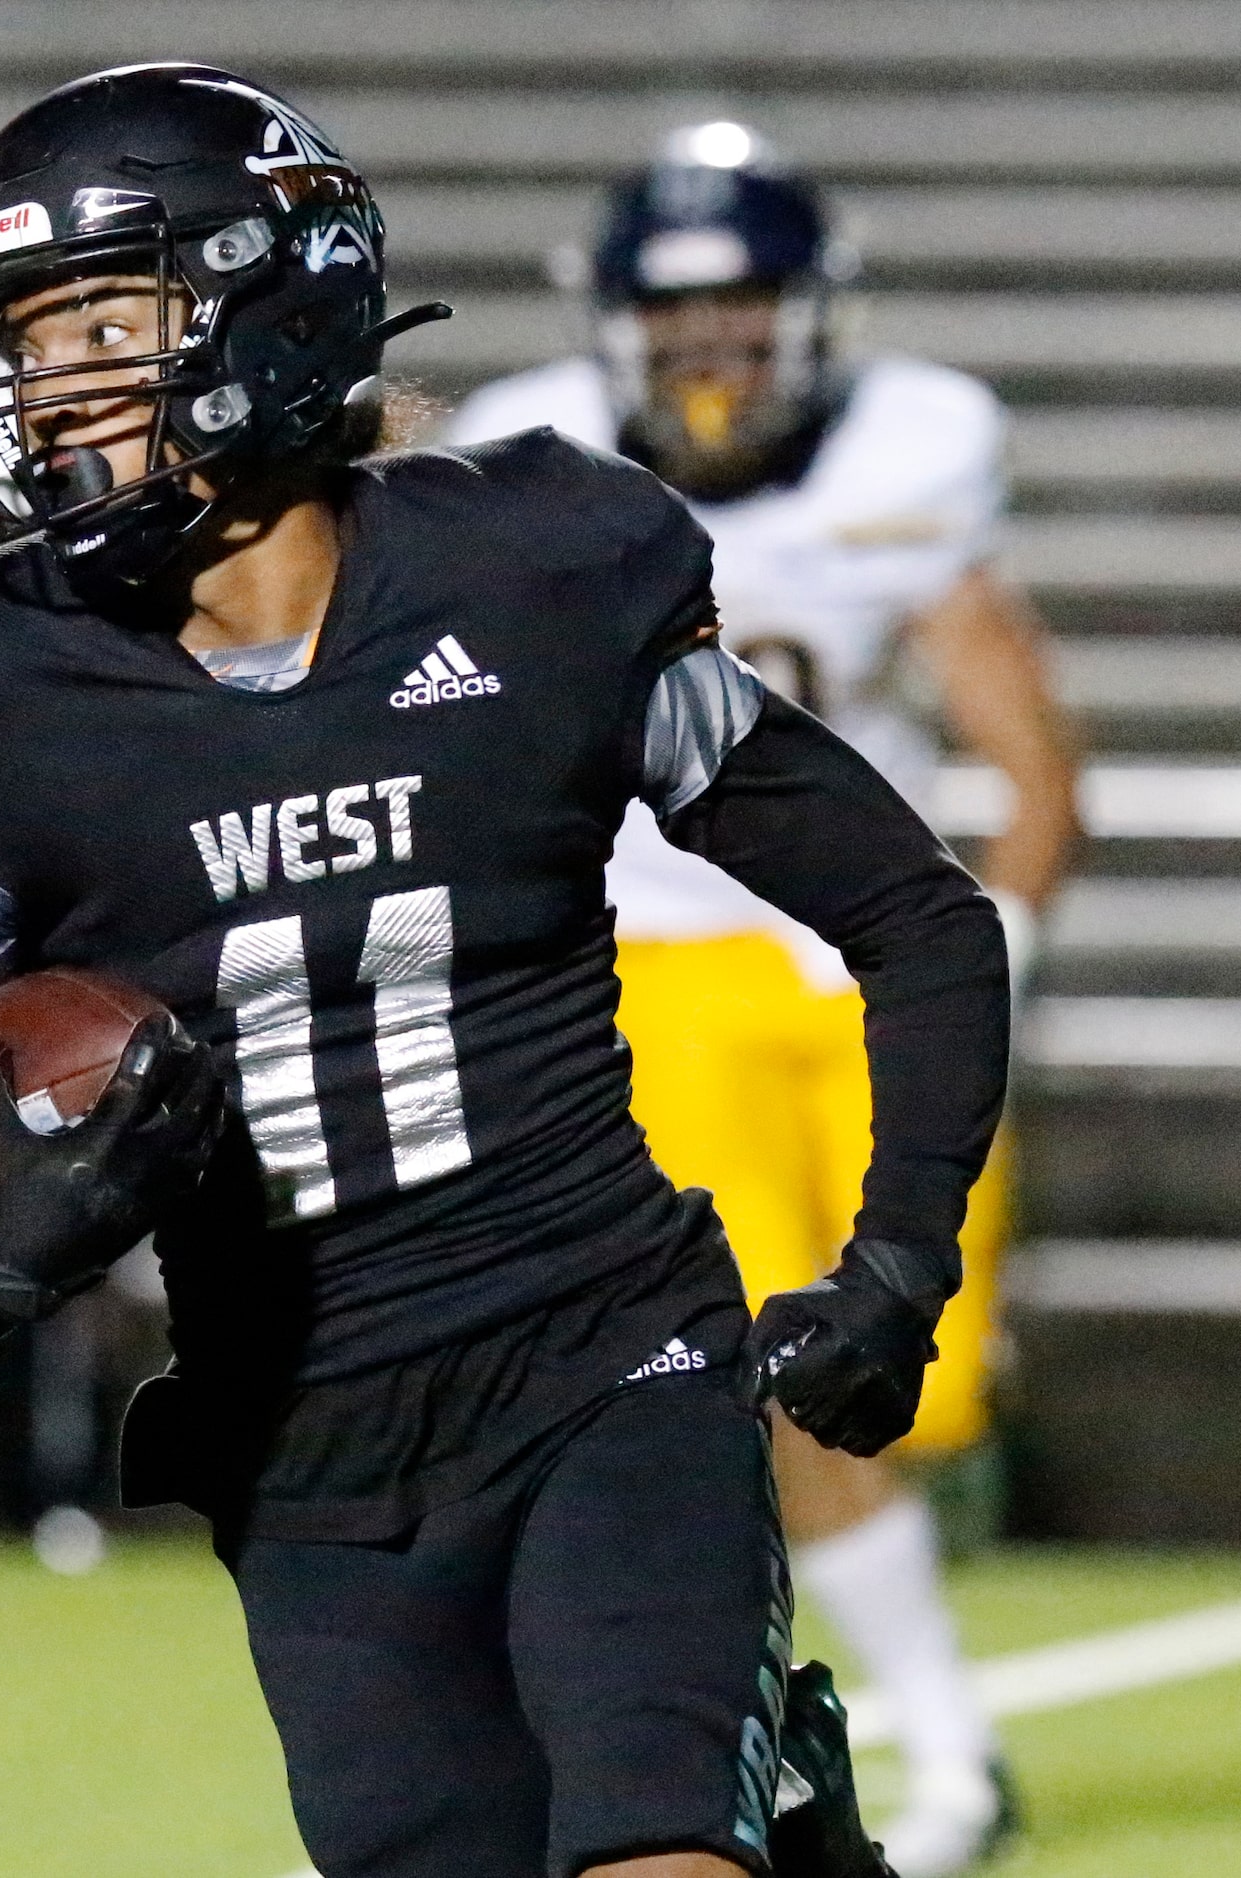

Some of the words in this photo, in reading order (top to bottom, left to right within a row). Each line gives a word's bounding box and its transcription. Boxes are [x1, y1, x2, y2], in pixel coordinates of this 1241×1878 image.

[389, 674, 502, 709] adidas
[190, 775, 423, 902] WEST
[216, 885, 472, 1222] 11
[626, 1350, 707, 1381] idas
